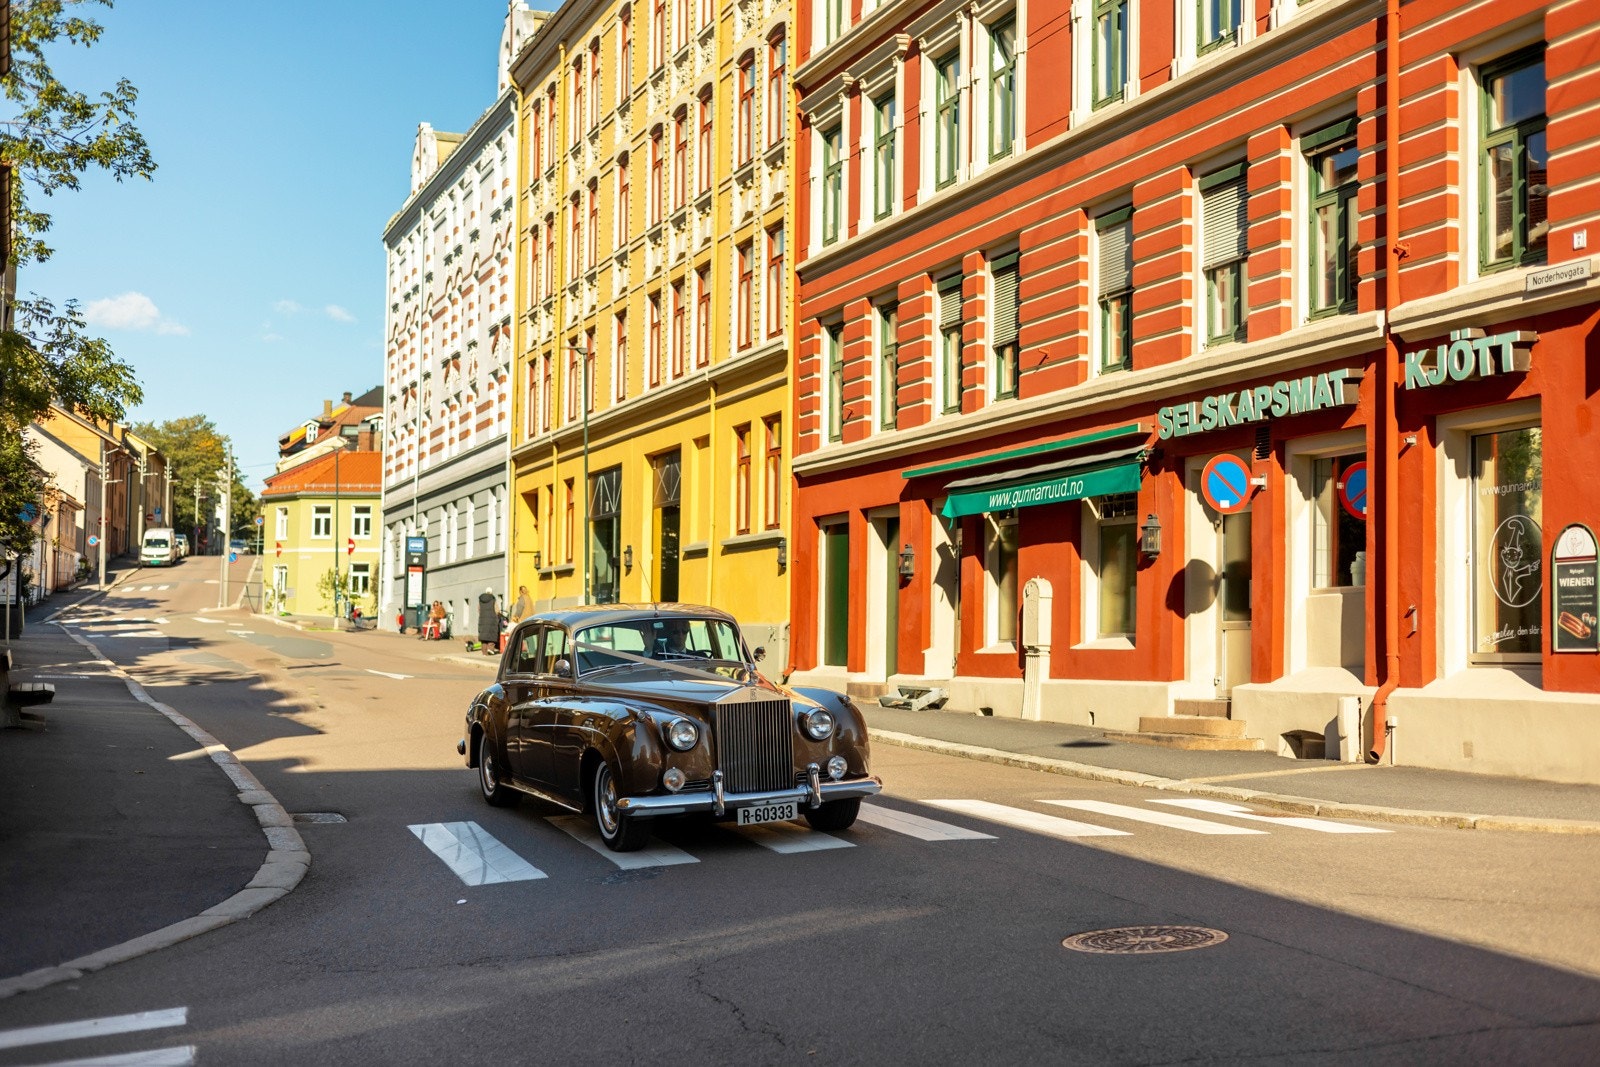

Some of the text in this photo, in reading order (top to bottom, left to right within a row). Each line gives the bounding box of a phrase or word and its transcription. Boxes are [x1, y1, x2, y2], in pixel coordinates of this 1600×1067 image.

[1532, 266, 1585, 286] Norderhovgata
[1404, 327, 1521, 390] KJÖTT
[1158, 368, 1350, 440] SELSKAPSMAT
[989, 478, 1084, 508] www.gunnarruud.no
[1558, 576, 1595, 588] WIENER!
[742, 804, 793, 824] R-60333
